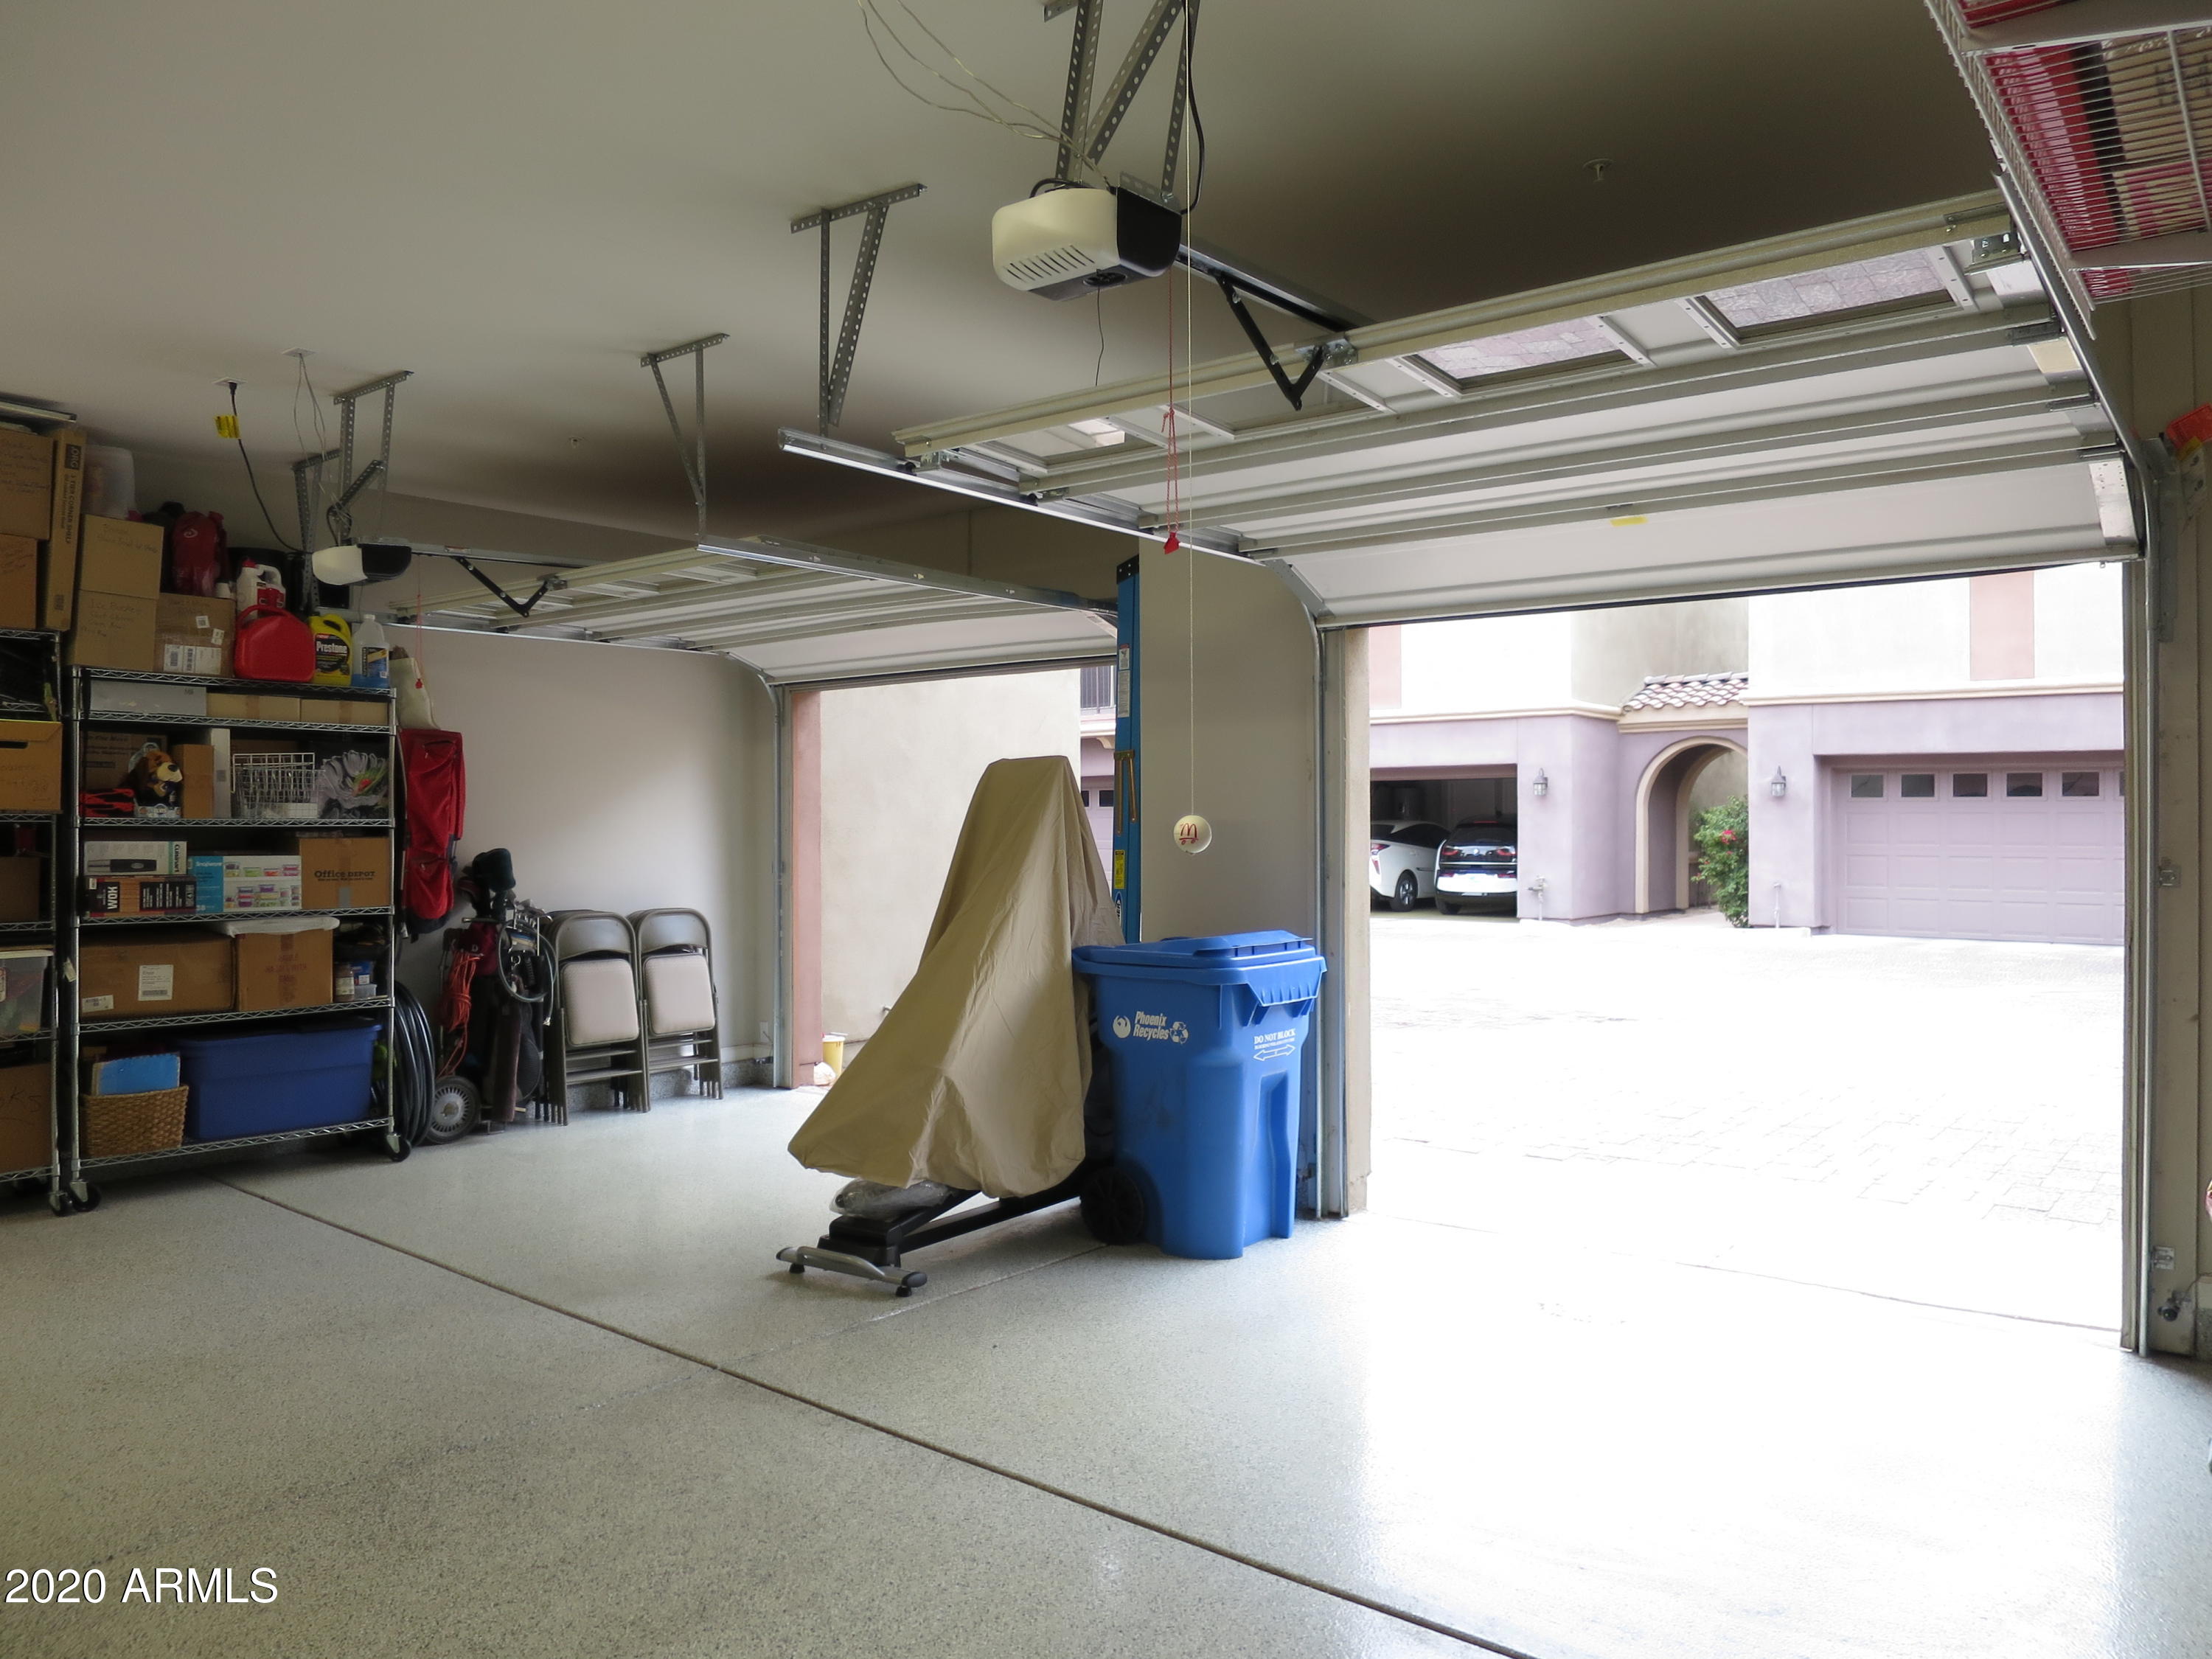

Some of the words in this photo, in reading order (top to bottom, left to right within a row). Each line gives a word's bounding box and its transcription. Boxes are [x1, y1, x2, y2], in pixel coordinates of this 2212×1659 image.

[316, 641, 347, 653] Prestone
[314, 869, 346, 878] Office
[107, 886, 118, 909] WOK
[1135, 1010, 1168, 1027] Phoenix
[1133, 1023, 1169, 1041] Recycles
[1253, 1035, 1264, 1044] DO
[1265, 1032, 1277, 1042] NOT
[1278, 1028, 1296, 1040] BLOCK
